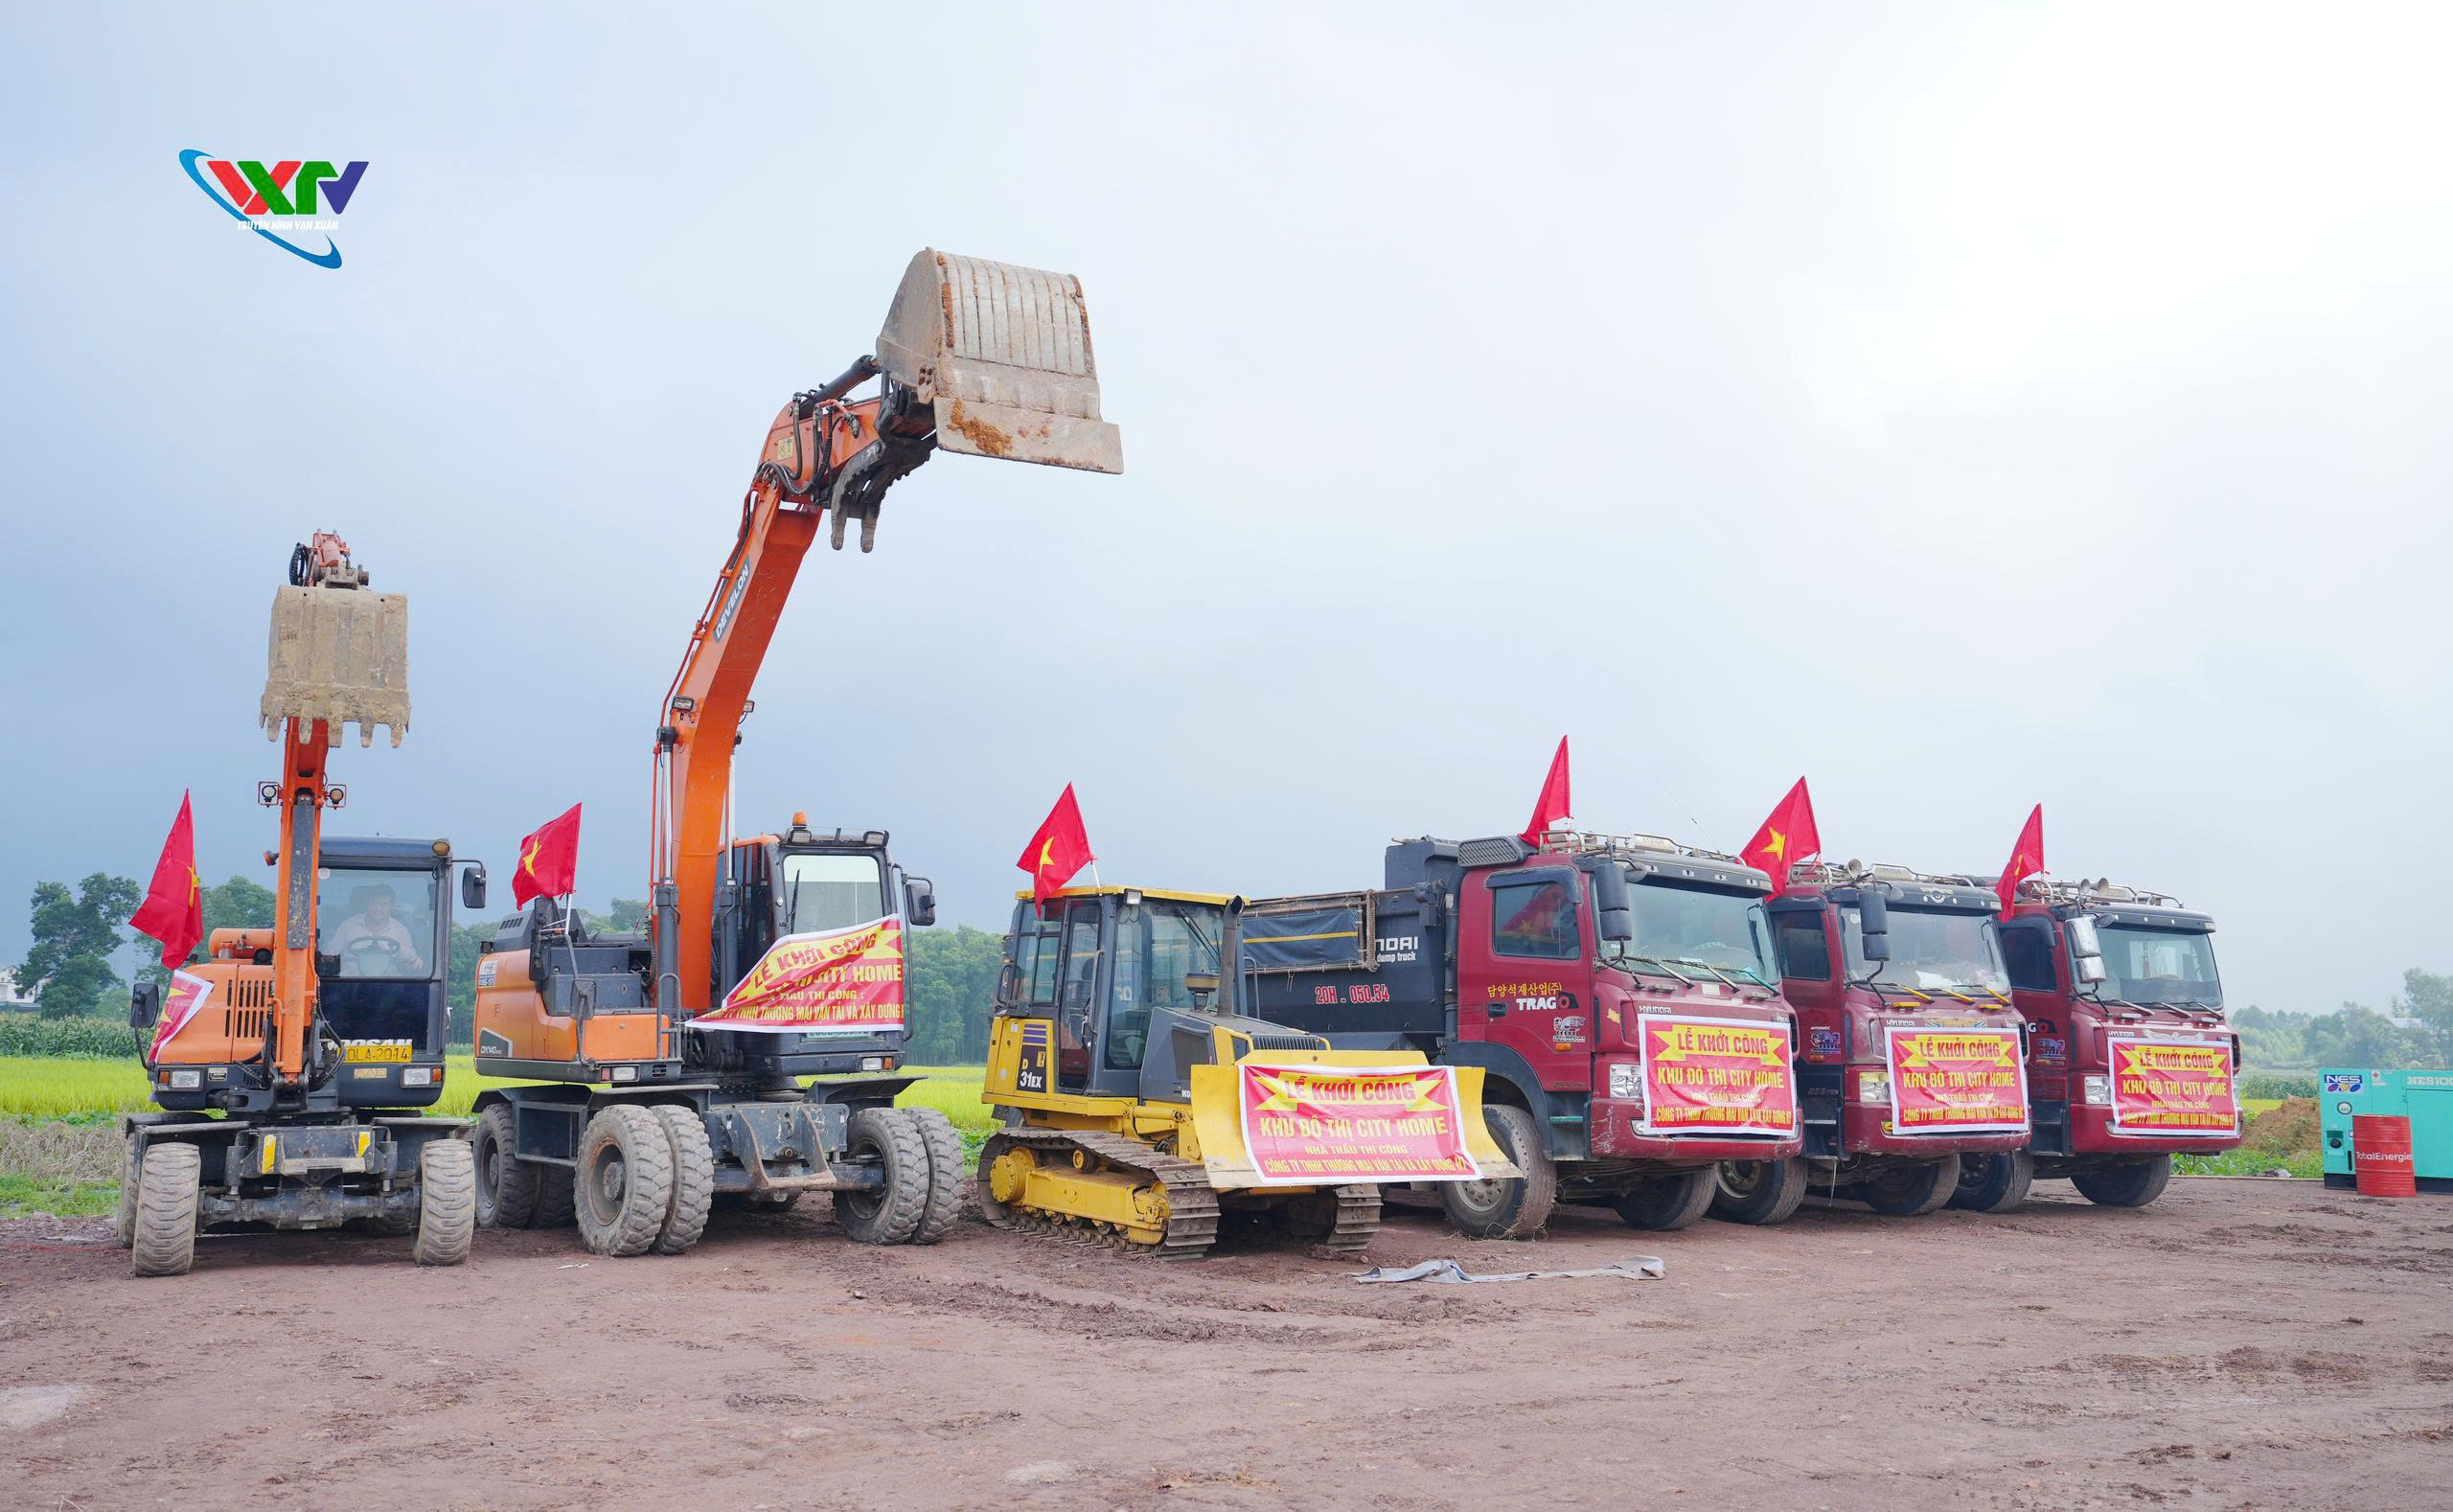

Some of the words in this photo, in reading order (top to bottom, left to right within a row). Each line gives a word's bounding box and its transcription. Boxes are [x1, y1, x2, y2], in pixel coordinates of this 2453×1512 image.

[715, 563, 749, 639] DEVELON
[830, 933, 877, 955] CÔNG
[1377, 953, 1397, 963] dump
[1398, 951, 1416, 961] truck
[853, 965, 903, 982] HOME
[808, 990, 825, 999] THI
[828, 988, 857, 999] CÔNG
[1315, 986, 1338, 1004] 20H
[1349, 983, 1389, 1004] 050.54
[1487, 982, 1562, 997] 담양석재산업(주)
[860, 1001, 876, 1019] XÂY
[1639, 1005, 1671, 1015] HYUNDAI
[1677, 1027, 1693, 1051] LỄ
[1698, 1030, 1729, 1053] KHỞI
[1733, 1034, 1768, 1055] CÔNG
[1919, 1037, 1934, 1058] LỄ
[1937, 1037, 1966, 1058] KHỞI
[1969, 1040, 2001, 1058] CÔNG
[1021, 1058, 1028, 1069] D
[2156, 1049, 2182, 1067] KHỞI
[2184, 1052, 2213, 1069] CÔNG
[1020, 1071, 1043, 1088] 31EX
[1658, 1066, 1683, 1085] KHU
[1686, 1063, 1704, 1085] ĐÔ
[1708, 1067, 1728, 1089] THỊ
[1730, 1069, 1753, 1087] CITY
[1754, 1071, 1785, 1088] HOME
[1903, 1072, 1927, 1088] KHU
[1949, 1072, 1966, 1090] THỊ
[1968, 1072, 1987, 1088] CITY
[1989, 1072, 2016, 1088] HOME
[2326, 1075, 2361, 1084] NES
[1285, 1075, 1307, 1099] LỄ
[1311, 1079, 1357, 1101] KHỞI
[1362, 1080, 1416, 1101] CÔNG
[2122, 1079, 2147, 1094] KHU
[2165, 1081, 2181, 1097] THỊ
[2183, 1082, 2201, 1096] CITY
[2203, 1082, 2228, 1097] HOME
[1260, 1117, 1295, 1138] KHU
[1326, 1118, 1354, 1141] THỊ
[1357, 1119, 1392, 1137] CITY
[1396, 1116, 1449, 1137] HOME
[1379, 1143, 1409, 1155] CÔNG
[2356, 1152, 2413, 1162] TotalEnergie
[1265, 1157, 1291, 1173] CÔNG
